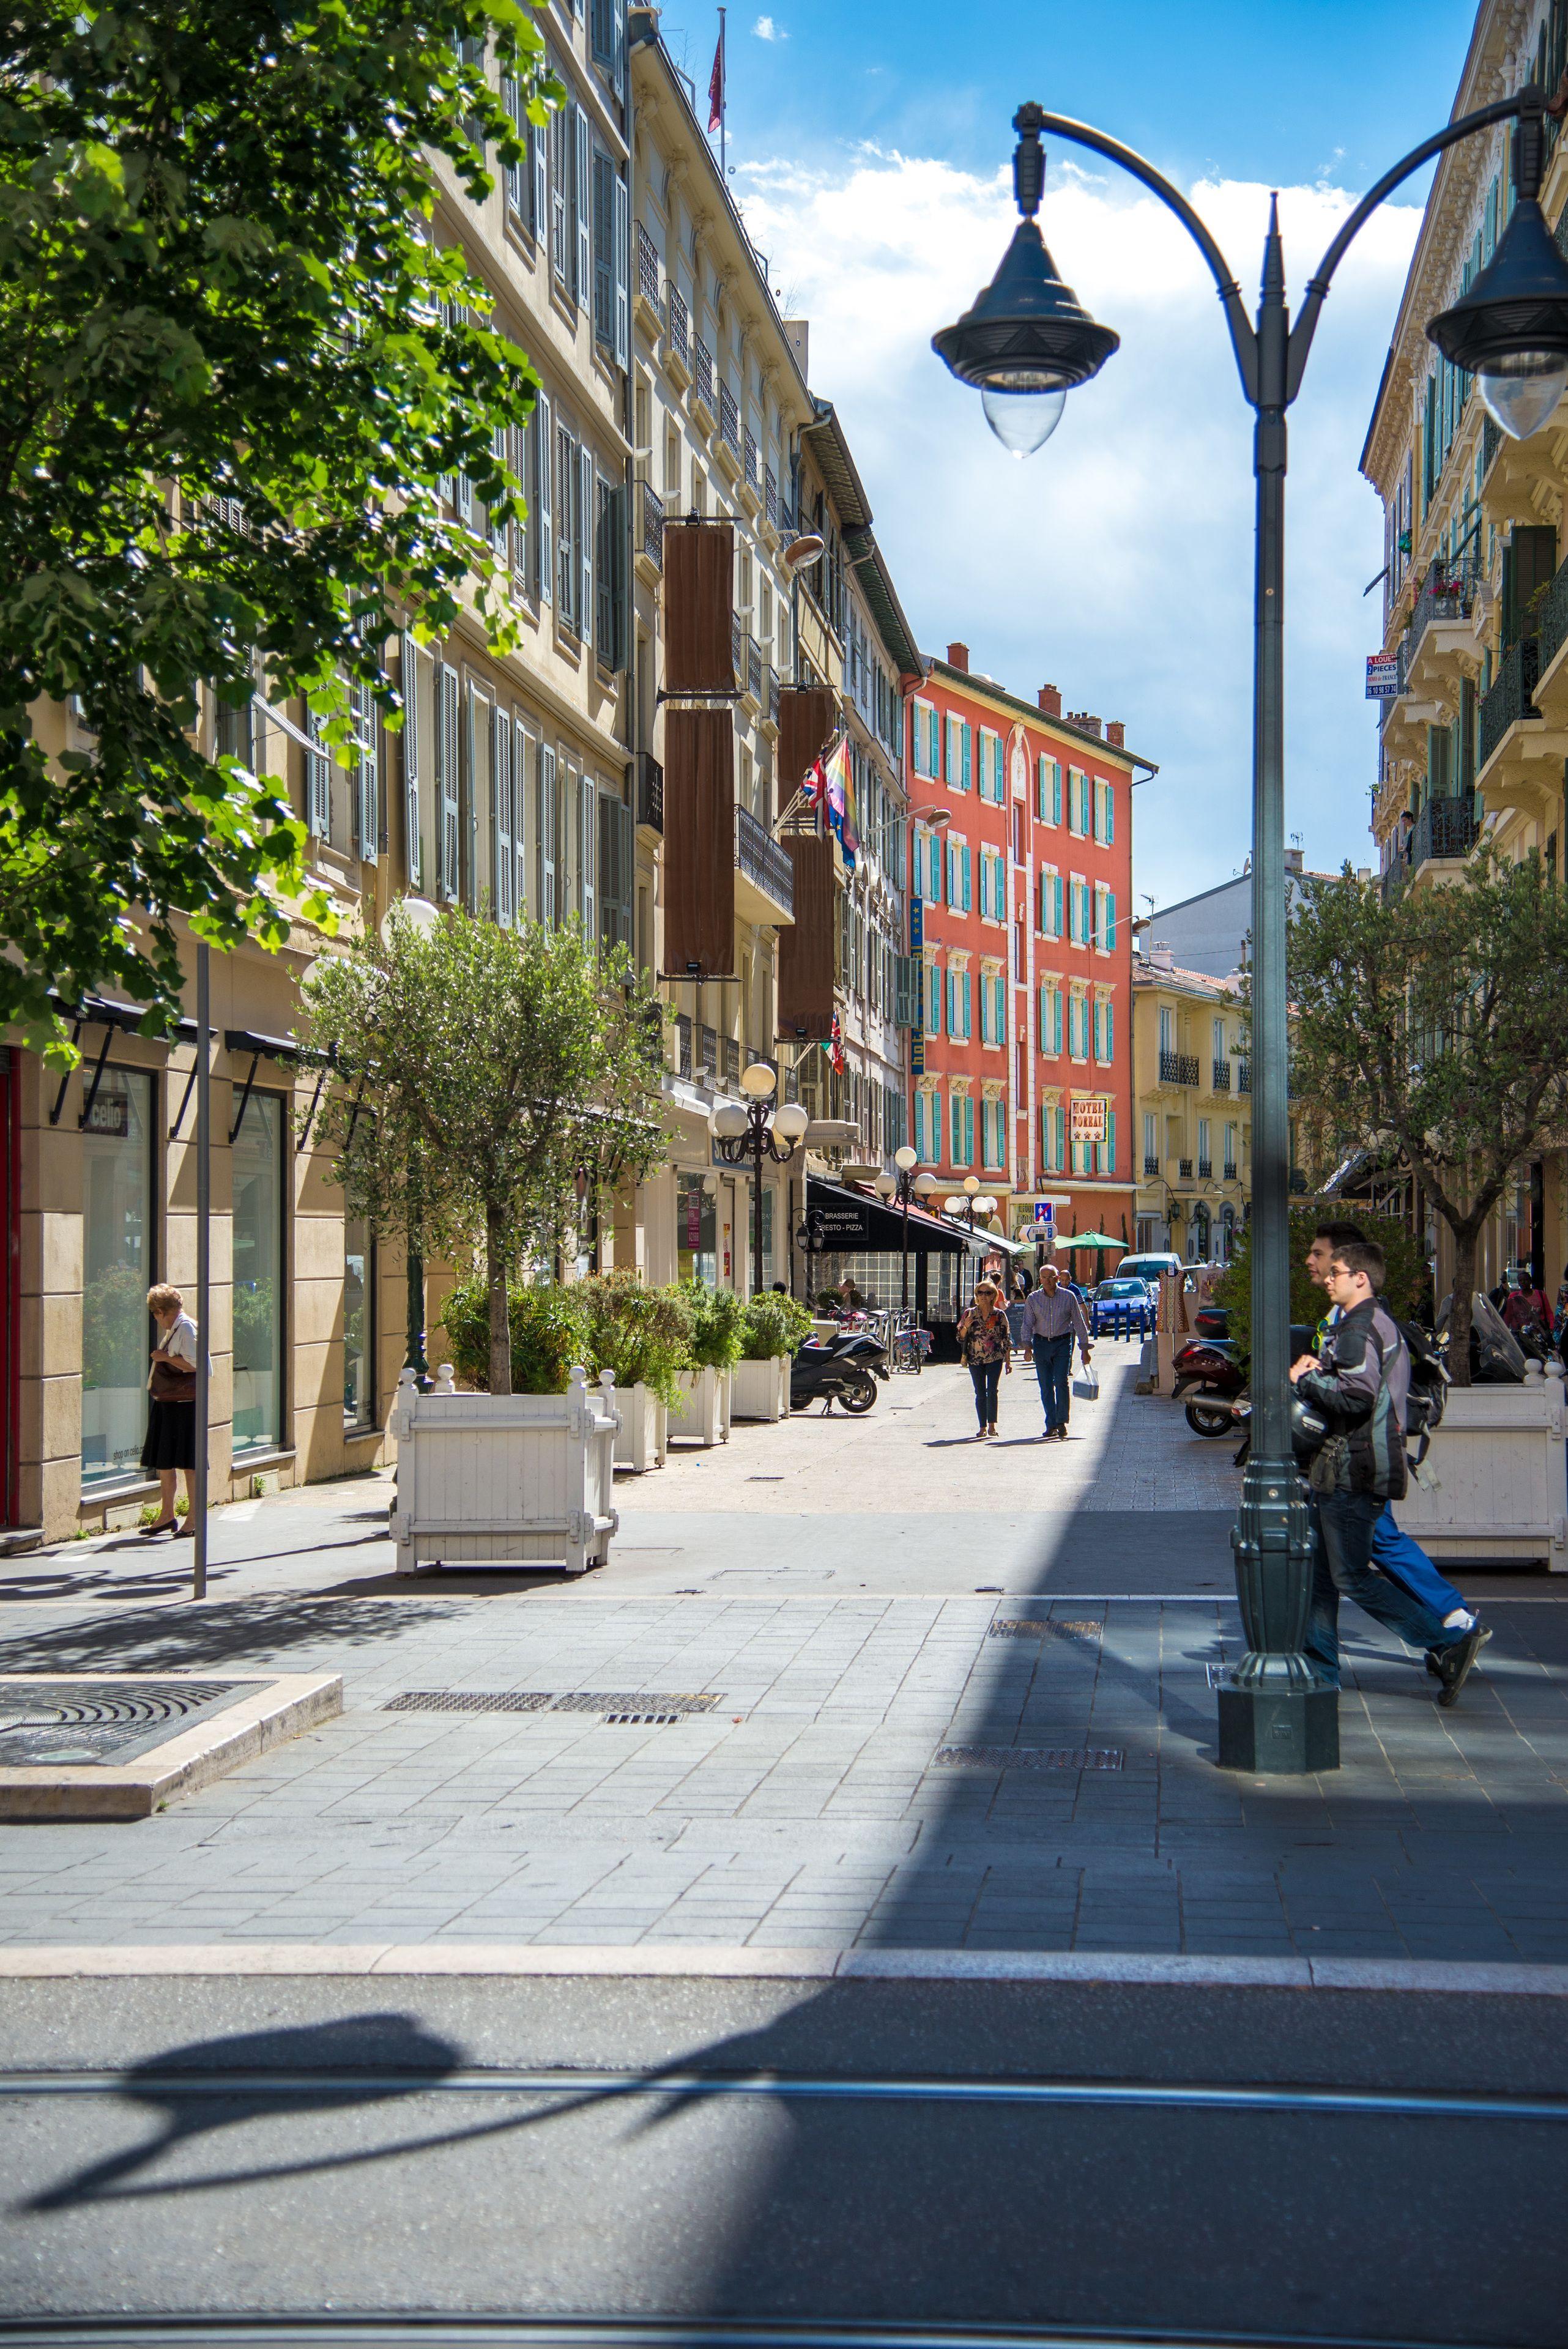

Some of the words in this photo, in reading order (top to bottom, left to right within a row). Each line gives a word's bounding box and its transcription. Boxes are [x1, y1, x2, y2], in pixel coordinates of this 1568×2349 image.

[92, 1097, 121, 1129] celio
[1072, 1102, 1103, 1114] HOTEL
[1072, 1116, 1103, 1127] BOREAL
[113, 1450, 123, 1461] shop
